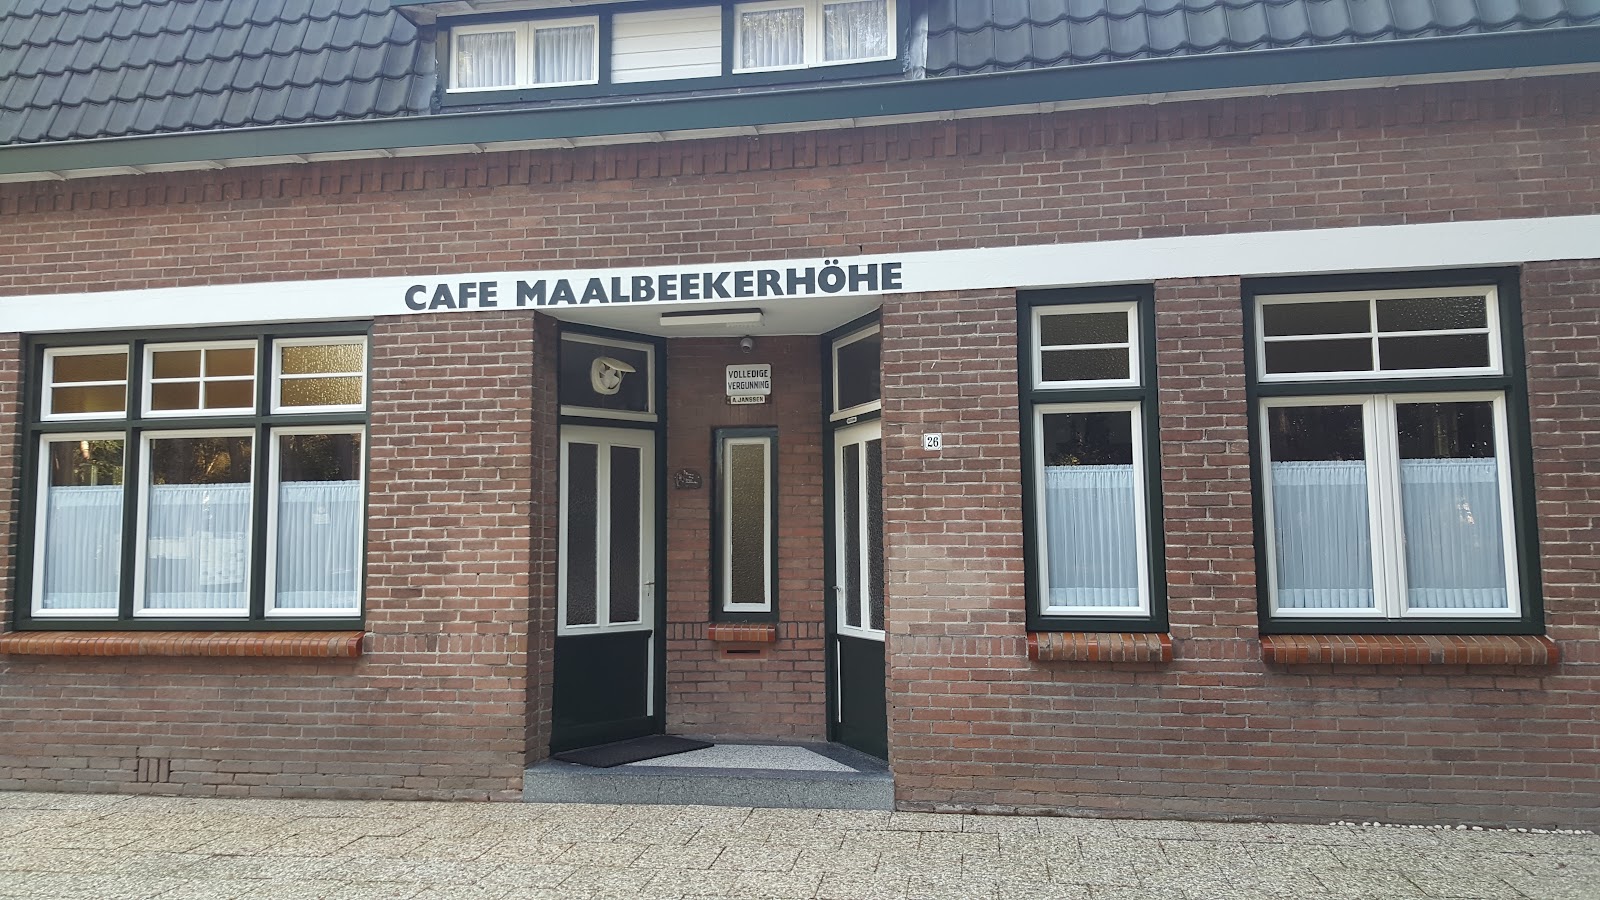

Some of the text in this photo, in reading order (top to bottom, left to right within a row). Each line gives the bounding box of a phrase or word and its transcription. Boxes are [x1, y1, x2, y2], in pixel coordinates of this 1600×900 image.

[405, 259, 902, 310] CAFE MAALBEEKERHÖHE
[728, 370, 768, 378] VOLLEDIGE
[728, 381, 769, 390] VERGUNNING
[927, 436, 939, 447] 26
